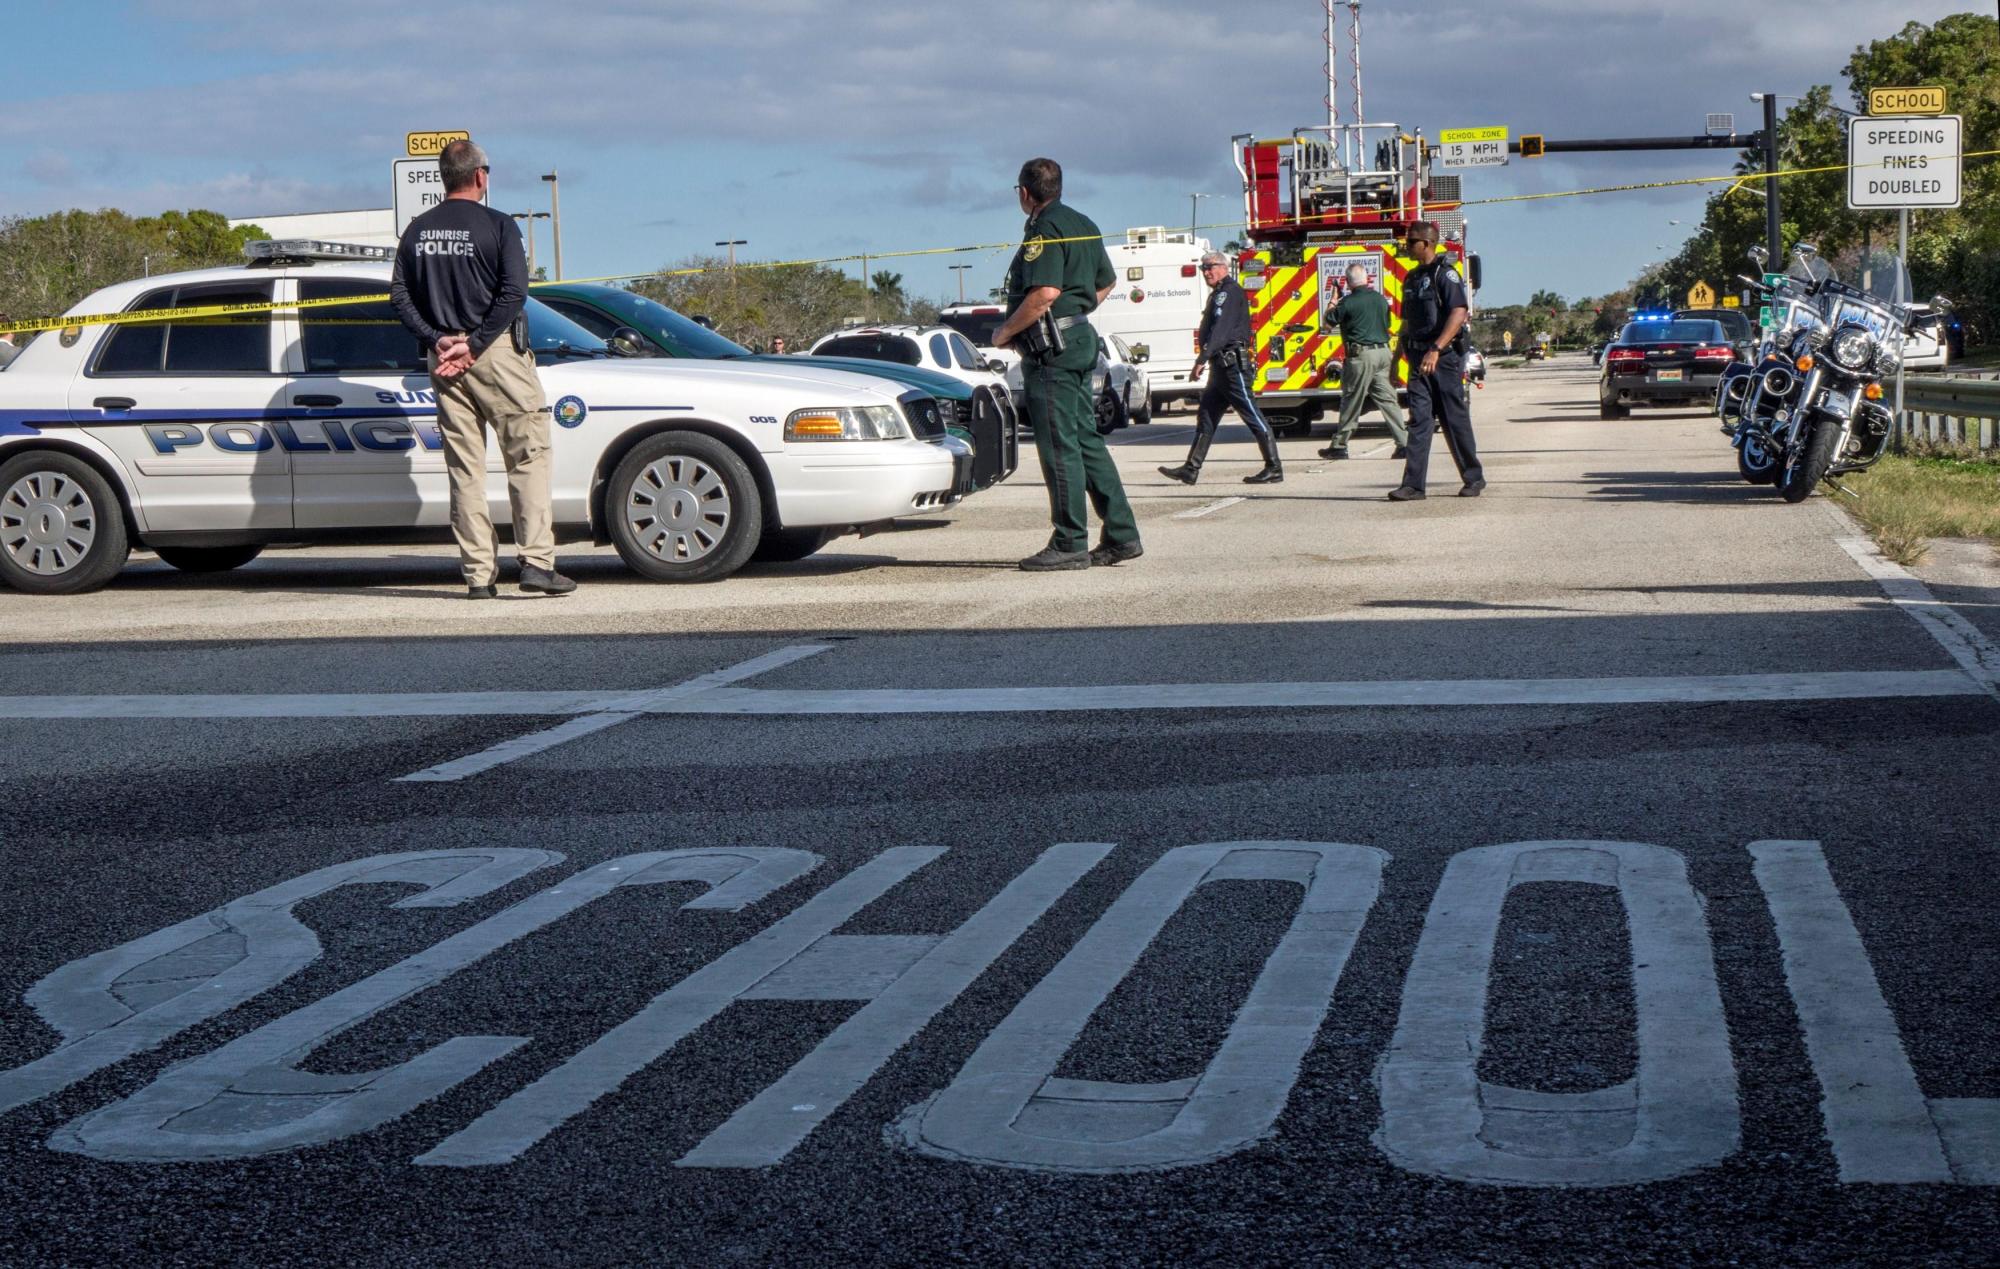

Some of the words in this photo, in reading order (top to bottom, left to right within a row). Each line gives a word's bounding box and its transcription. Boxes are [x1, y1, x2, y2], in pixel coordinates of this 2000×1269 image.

[1875, 93, 1940, 109] SCHOOL
[1447, 131, 1477, 140] SCHOOL
[1481, 129, 1502, 138] ZONE
[1867, 130, 1945, 145] SPEEDING
[411, 135, 462, 150] SCHO
[1451, 145, 1463, 156] 15
[1473, 143, 1498, 155] MPH
[1444, 158, 1465, 166] WHEN
[1470, 155, 1505, 164] FLASHING
[1883, 155, 1928, 169] FINES
[408, 170, 441, 184] SPEE
[1869, 180, 1941, 195] DOUBLED
[422, 192, 447, 205] FIN
[420, 229, 470, 241] SUNRISE
[415, 241, 474, 257] POLICE
[1324, 260, 1345, 268] CORAL
[1324, 274, 1378, 292] FIE
[1147, 290, 1166, 298] Public
[1167, 289, 1191, 297] Schools
[749, 415, 778, 424] 005
[0, 838, 2000, 1190] SCHOOL
